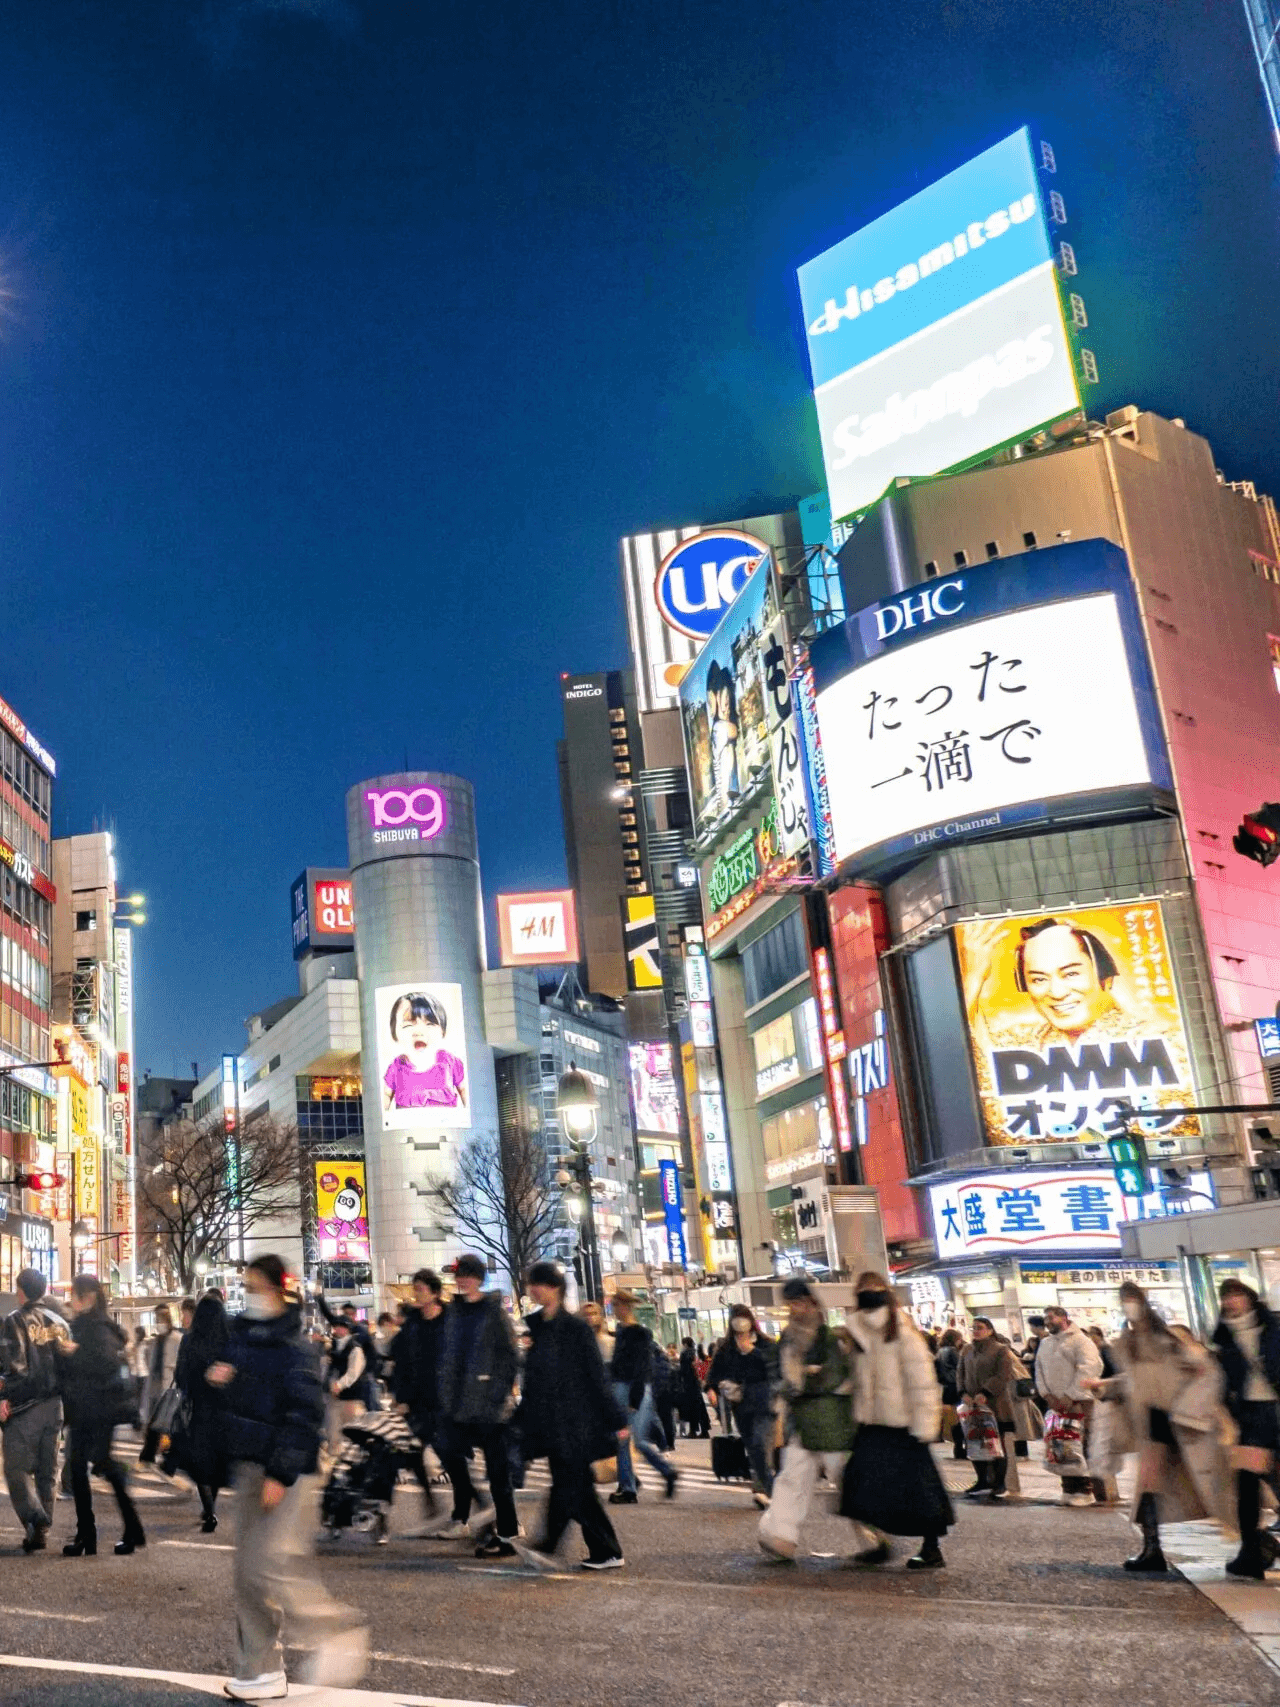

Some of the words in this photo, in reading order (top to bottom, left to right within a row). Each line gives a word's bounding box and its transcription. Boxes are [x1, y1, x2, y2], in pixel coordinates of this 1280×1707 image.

[808, 192, 1036, 336] Hisamitsu
[873, 579, 967, 641] DHC
[566, 688, 602, 699] INDIGO
[862, 650, 1028, 740] たった
[869, 718, 1042, 793] 一滴で
[368, 788, 443, 839] 109
[373, 828, 419, 843] SHIBUYA
[914, 827, 943, 844] DHC
[943, 812, 1001, 835] Channel
[992, 1038, 1181, 1097] DMM
[22, 1221, 50, 1251] LUSH
[941, 1184, 1160, 1240] 大盛堂書
